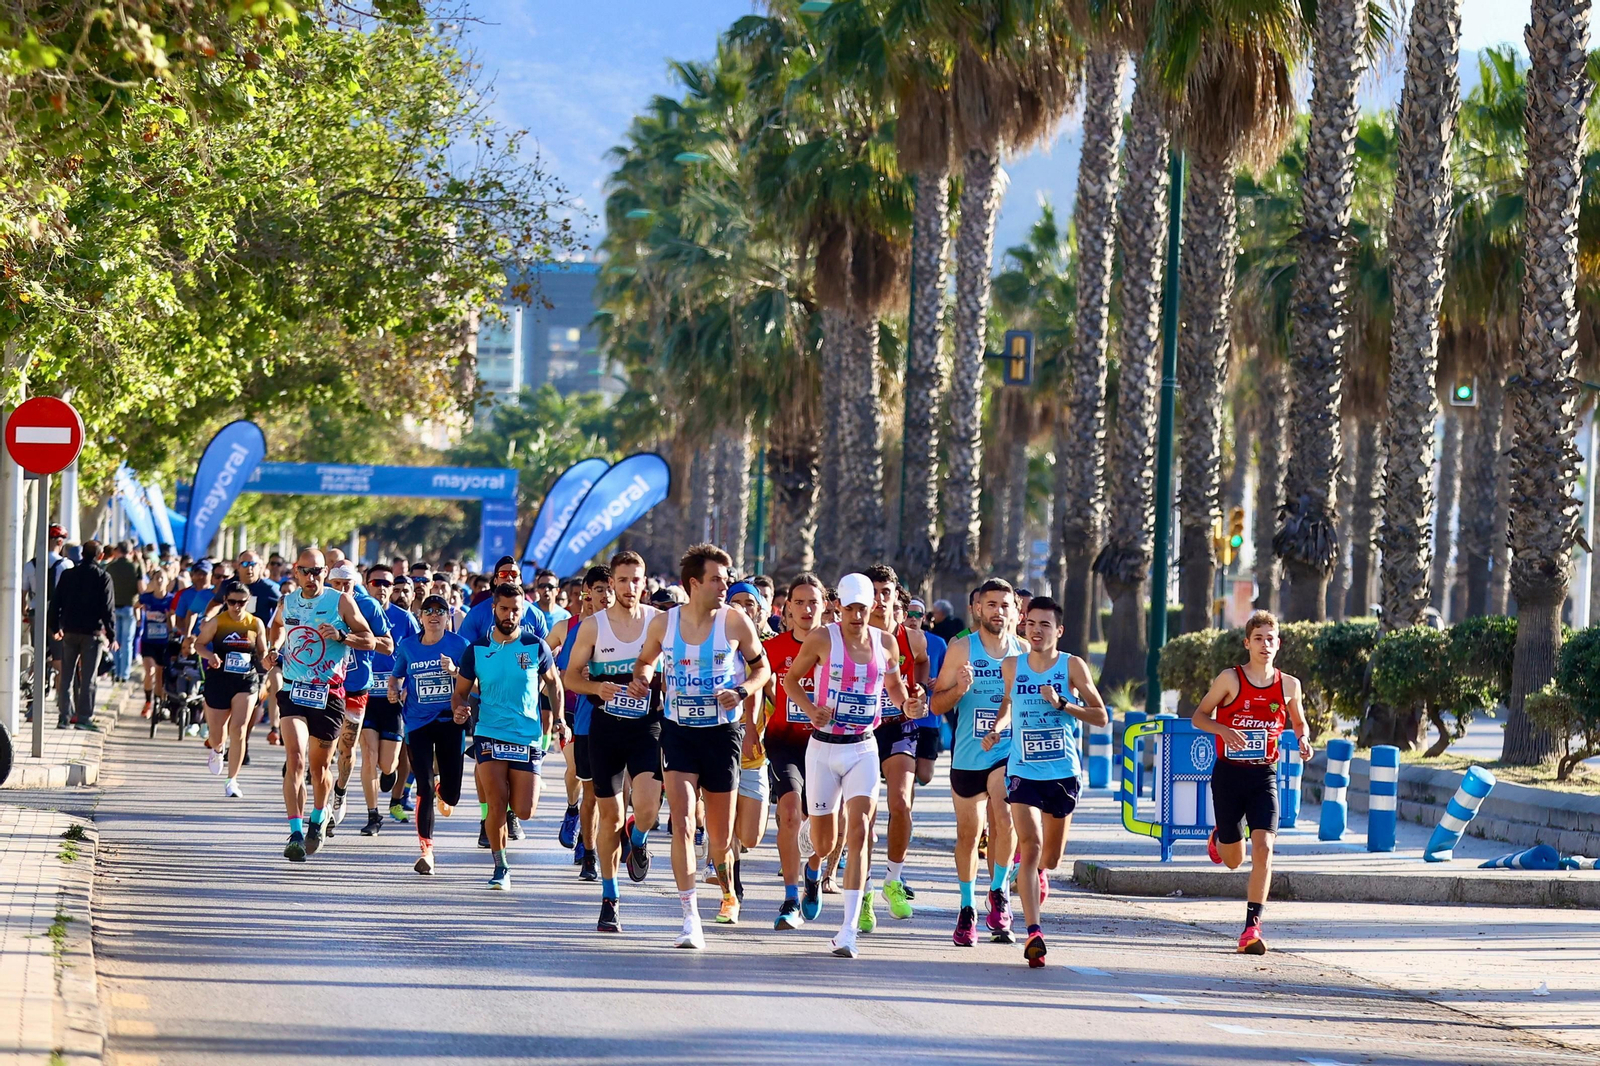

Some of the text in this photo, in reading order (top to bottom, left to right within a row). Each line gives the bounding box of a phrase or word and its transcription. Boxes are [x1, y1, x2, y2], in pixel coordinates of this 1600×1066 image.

[194, 443, 250, 529] mayoral
[432, 473, 505, 491] mayoral
[568, 474, 650, 554] mayoral
[411, 659, 441, 669] mayor
[604, 662, 636, 674] inac
[974, 666, 1003, 679] nerj
[295, 690, 323, 699] 1669
[421, 686, 449, 695] 1773
[613, 696, 644, 709] 1992
[688, 707, 705, 716] 26
[849, 704, 866, 714] 25
[496, 744, 525, 752] 1955
[1027, 740, 1060, 750] 2156
